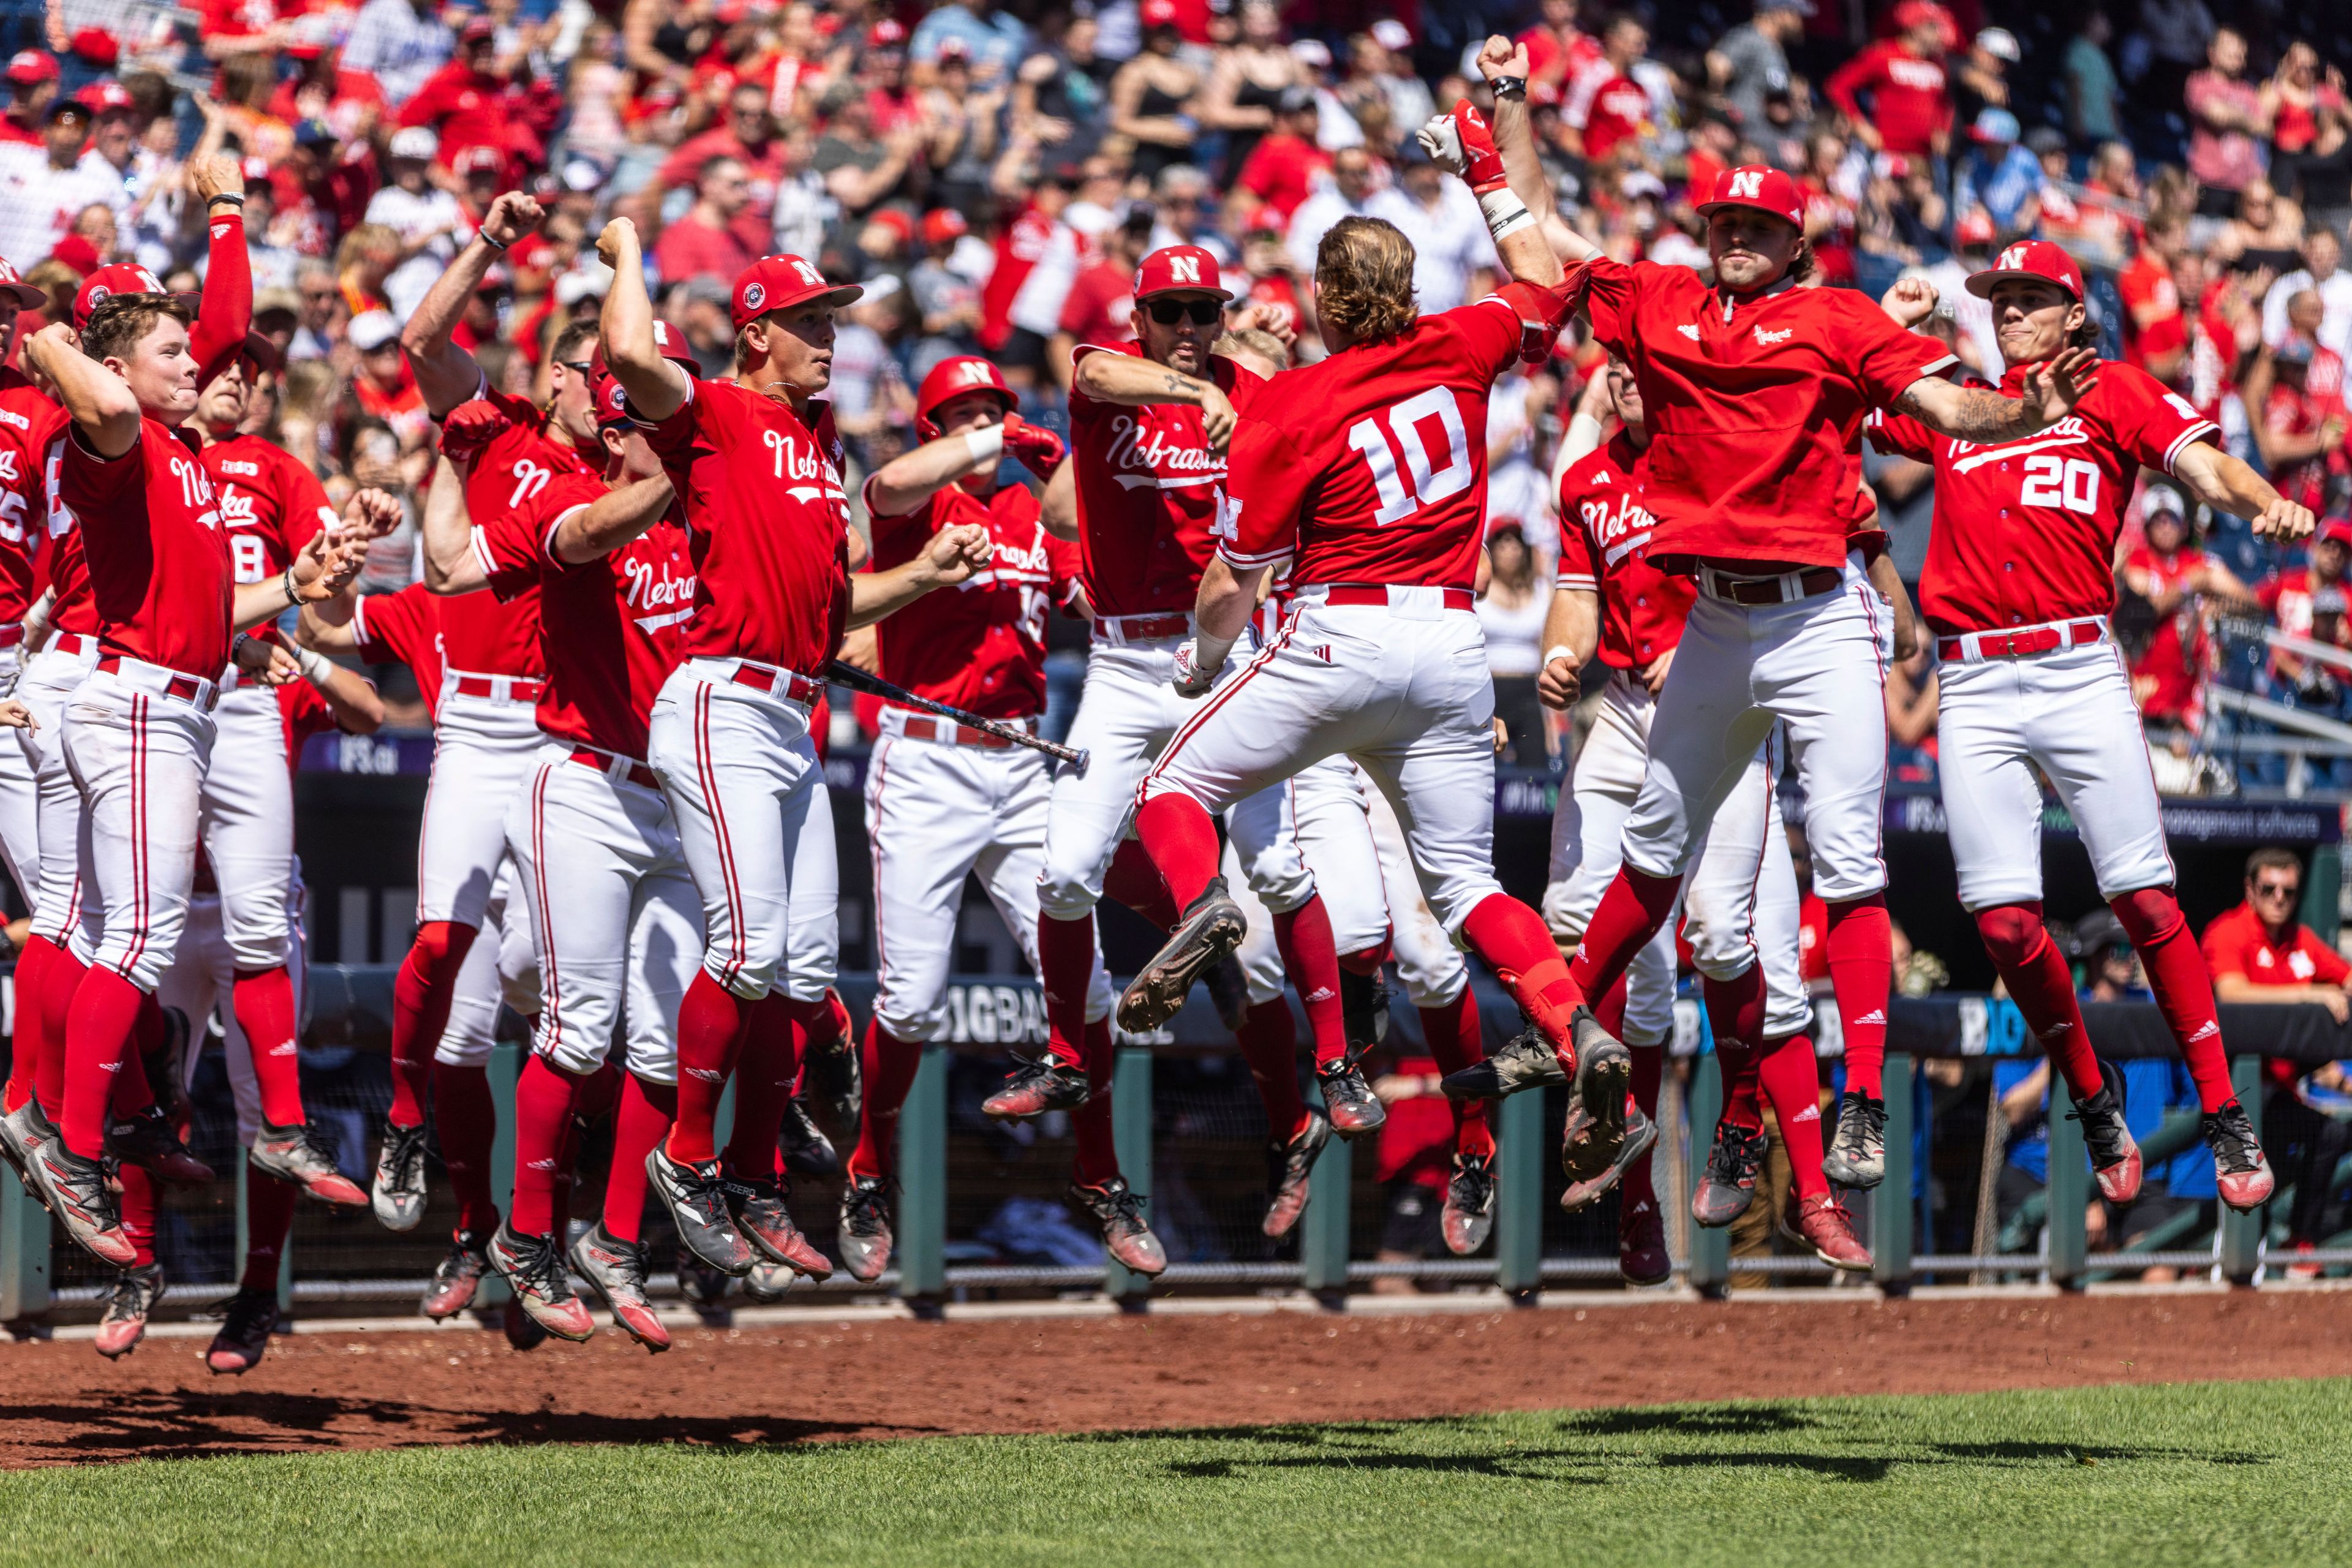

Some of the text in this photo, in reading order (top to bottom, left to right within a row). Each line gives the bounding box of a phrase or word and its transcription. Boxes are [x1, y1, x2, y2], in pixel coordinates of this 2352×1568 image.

[1728, 171, 1764, 198] N
[1170, 255, 1201, 284] N
[1997, 247, 2027, 270] N
[790, 260, 826, 286] N
[1753, 324, 1793, 345] Huskers
[960, 361, 994, 385] N
[1348, 385, 1472, 527] 10
[2021, 455, 2100, 516] 20
